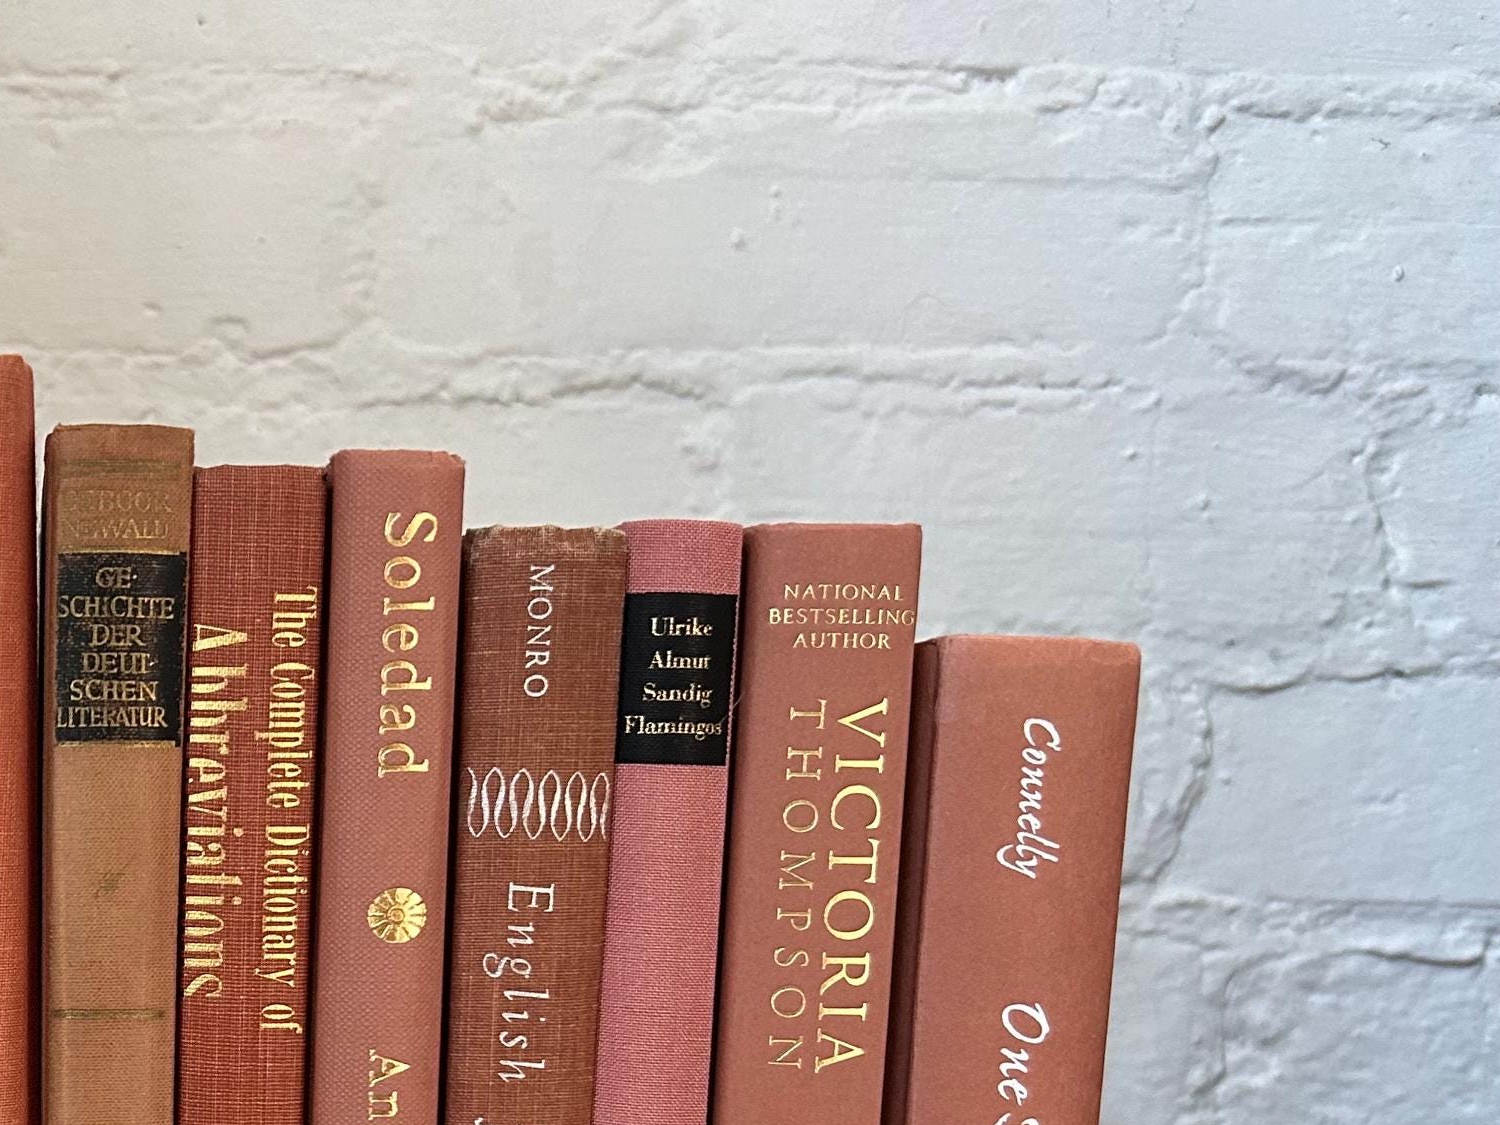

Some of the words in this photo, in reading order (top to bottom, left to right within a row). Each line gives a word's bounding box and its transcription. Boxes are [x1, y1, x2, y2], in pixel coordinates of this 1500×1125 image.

[58, 596, 176, 620] SCHICHTE
[783, 583, 903, 602] NATIONAL
[269, 585, 319, 648] The
[523, 563, 556, 698] MONRO
[650, 616, 714, 637] Ulrike
[768, 607, 916, 627] BESTSELLING
[91, 624, 146, 647] DER
[377, 511, 439, 779] Soledad
[792, 632, 892, 650] AUTHOR
[648, 650, 713, 670] Almut
[69, 680, 159, 701] SCHEN
[642, 682, 713, 709] Sandig
[56, 706, 169, 728] LITERATUR
[624, 715, 723, 741] Flamingos
[253, 661, 315, 809] Complete
[182, 623, 249, 999] Abbreviations
[996, 716, 1061, 879] Connelly
[767, 699, 827, 1072] THOMPSON
[813, 698, 889, 1074] VICTORIA
[254, 825, 311, 988] Dictionary
[482, 881, 556, 1084] English
[259, 1002, 304, 1034] of
[997, 1001, 1050, 1107] One
